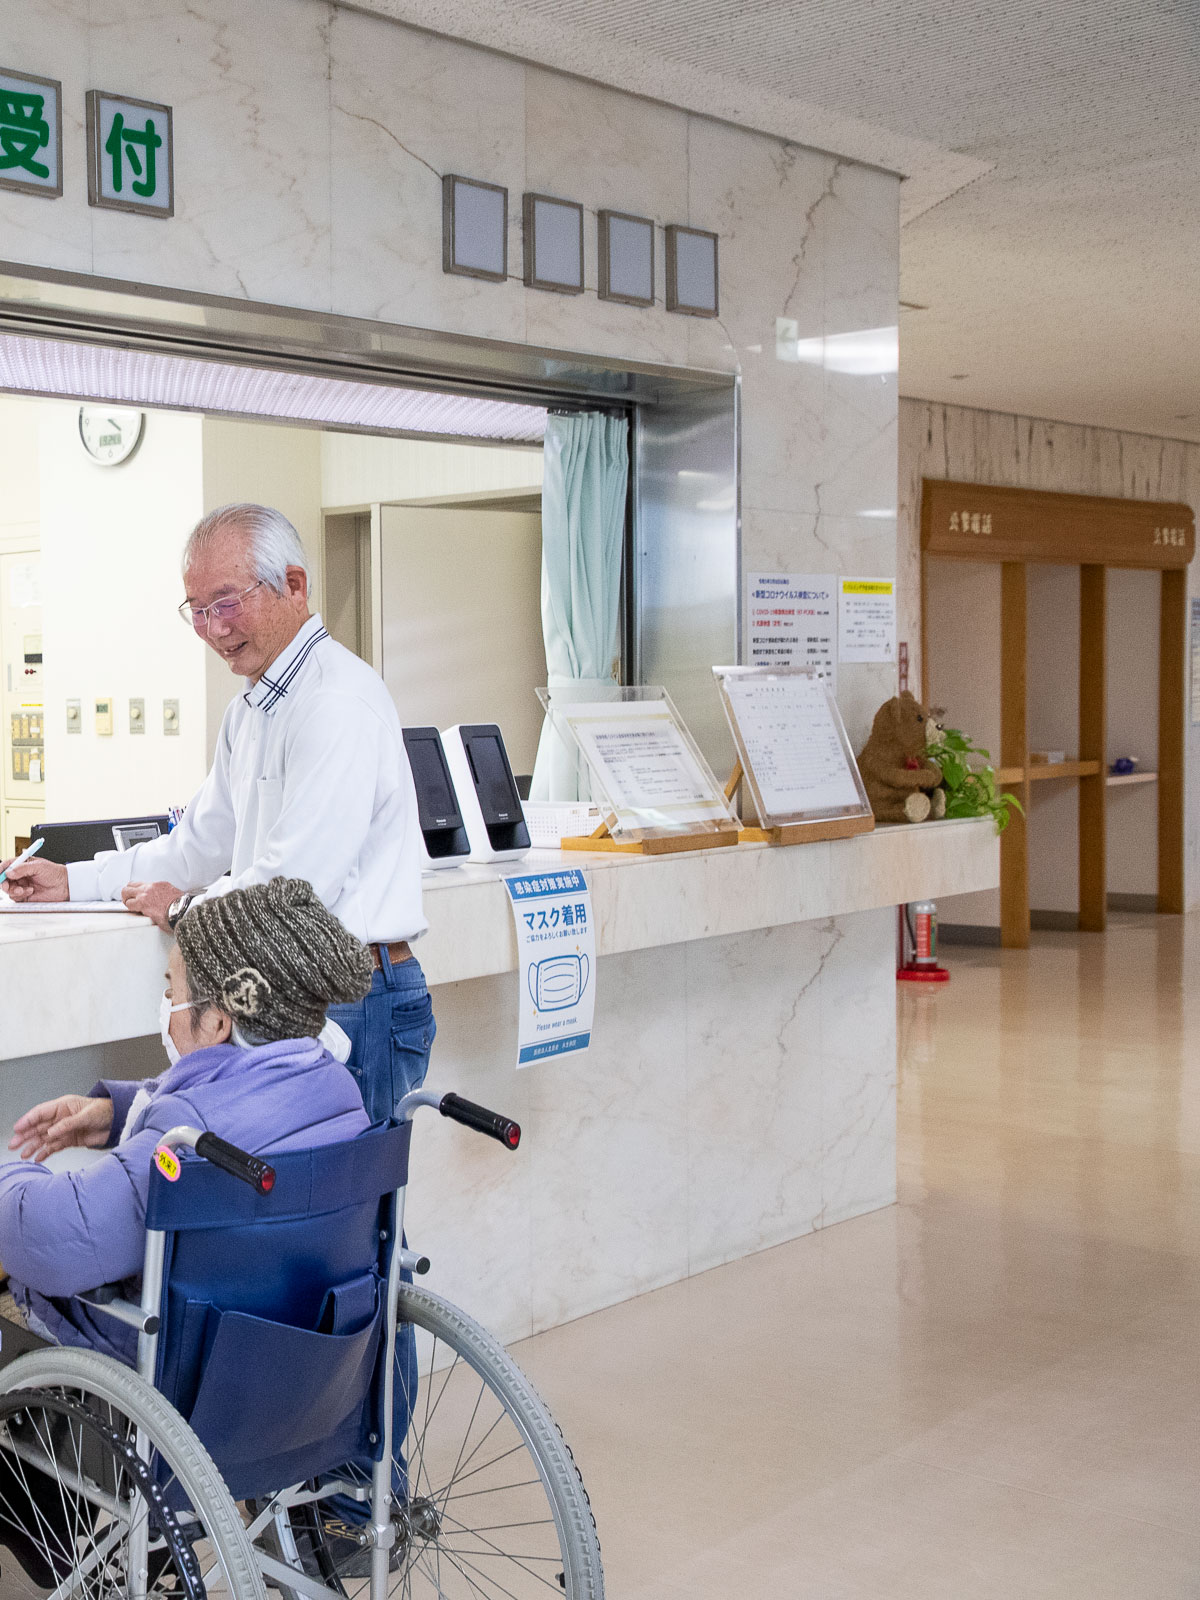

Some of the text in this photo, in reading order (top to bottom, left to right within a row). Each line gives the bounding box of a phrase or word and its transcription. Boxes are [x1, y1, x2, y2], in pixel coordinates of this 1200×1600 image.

[514, 875, 580, 895] 感染症対策実施中
[523, 903, 587, 931] マスク着用
[536, 1023, 551, 1032] Please
[552, 1021, 562, 1029] wear
